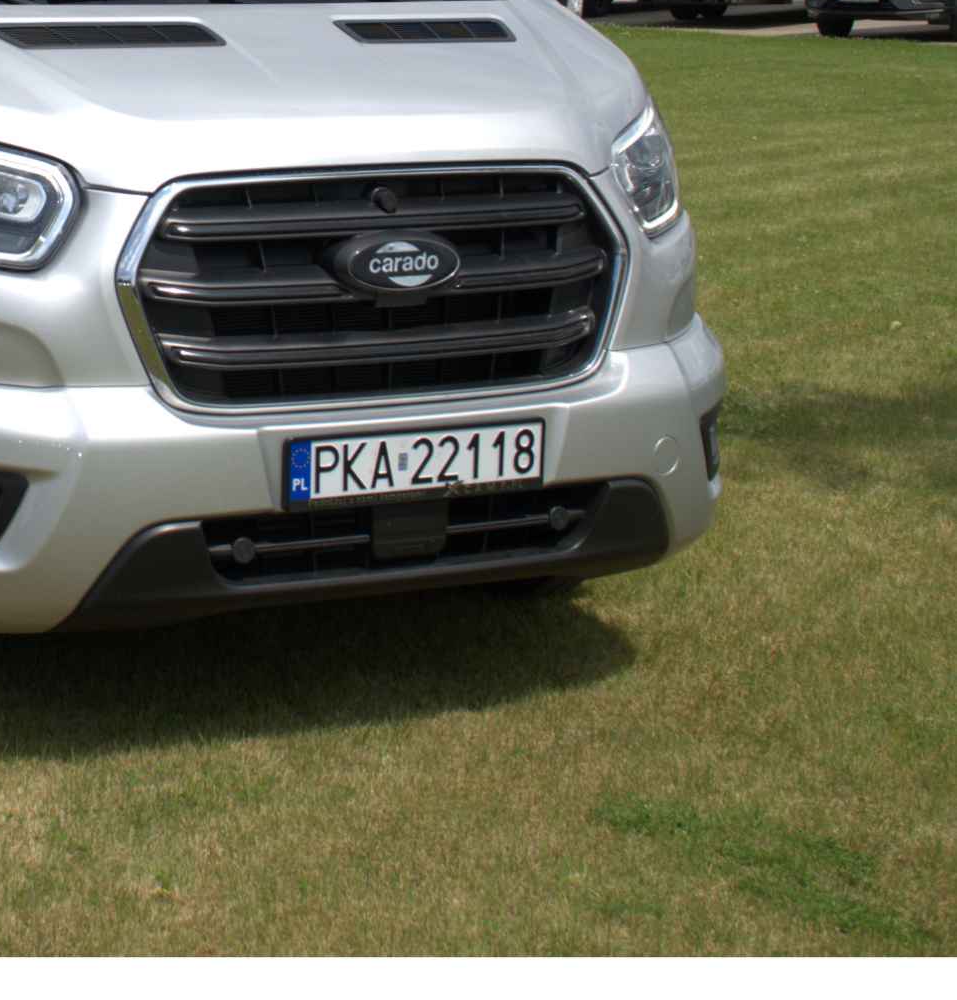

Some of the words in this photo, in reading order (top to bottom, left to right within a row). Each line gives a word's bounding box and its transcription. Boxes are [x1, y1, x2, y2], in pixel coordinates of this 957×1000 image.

[369, 252, 439, 273] carado
[314, 441, 394, 494] PKA
[411, 429, 535, 485] 22118
[292, 478, 308, 492] PL
